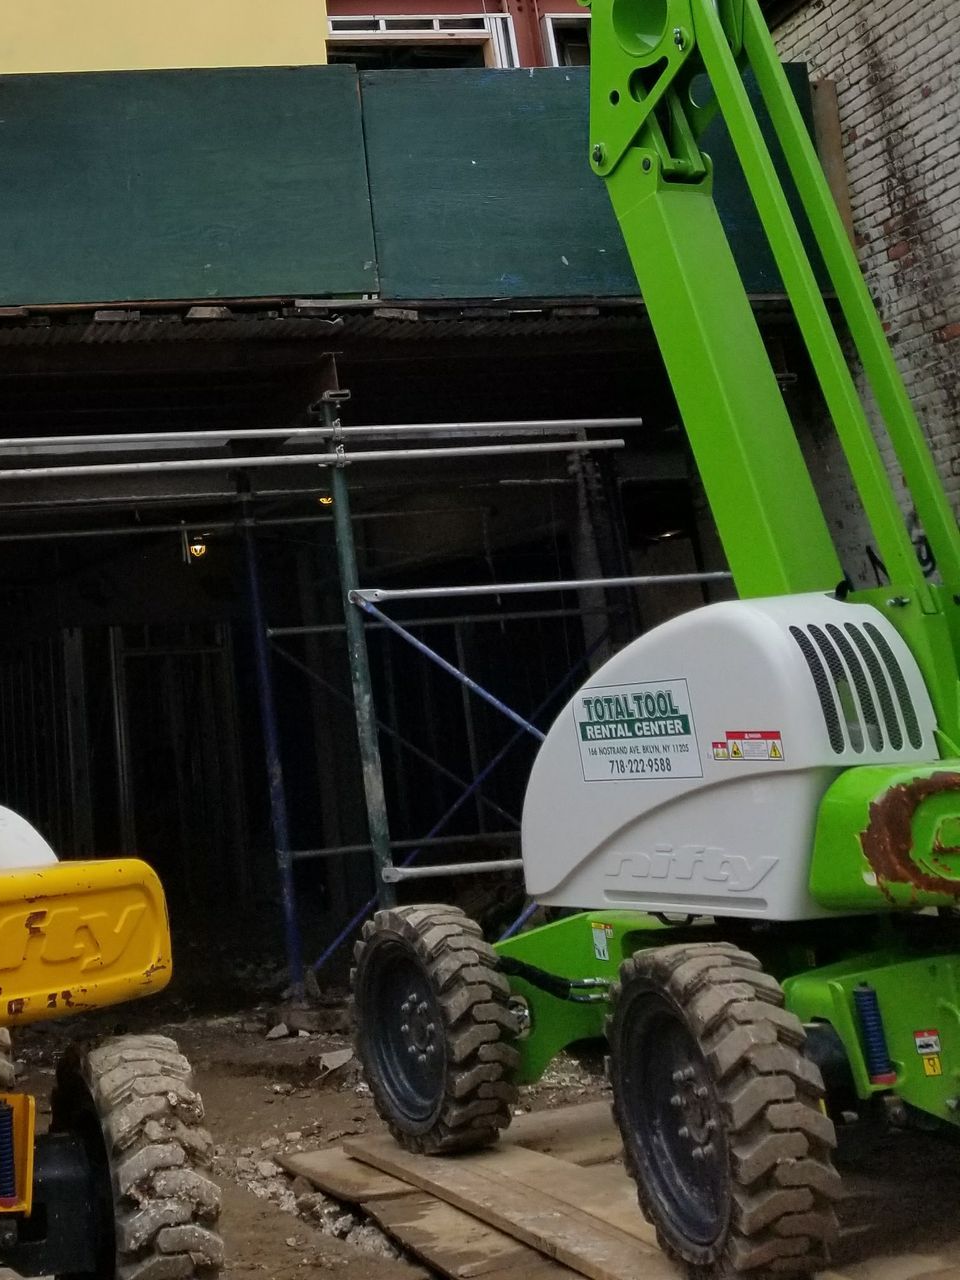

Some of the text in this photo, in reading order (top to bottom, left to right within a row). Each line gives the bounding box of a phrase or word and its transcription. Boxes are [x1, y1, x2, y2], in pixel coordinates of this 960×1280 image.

[582, 690, 679, 721] TOTAL TOOL
[586, 720, 684, 739] RENTAL CENTER
[588, 747, 598, 756] 166
[599, 745, 628, 756] NOSTRAND
[662, 744, 671, 753] NY
[603, 843, 780, 893] nifty
